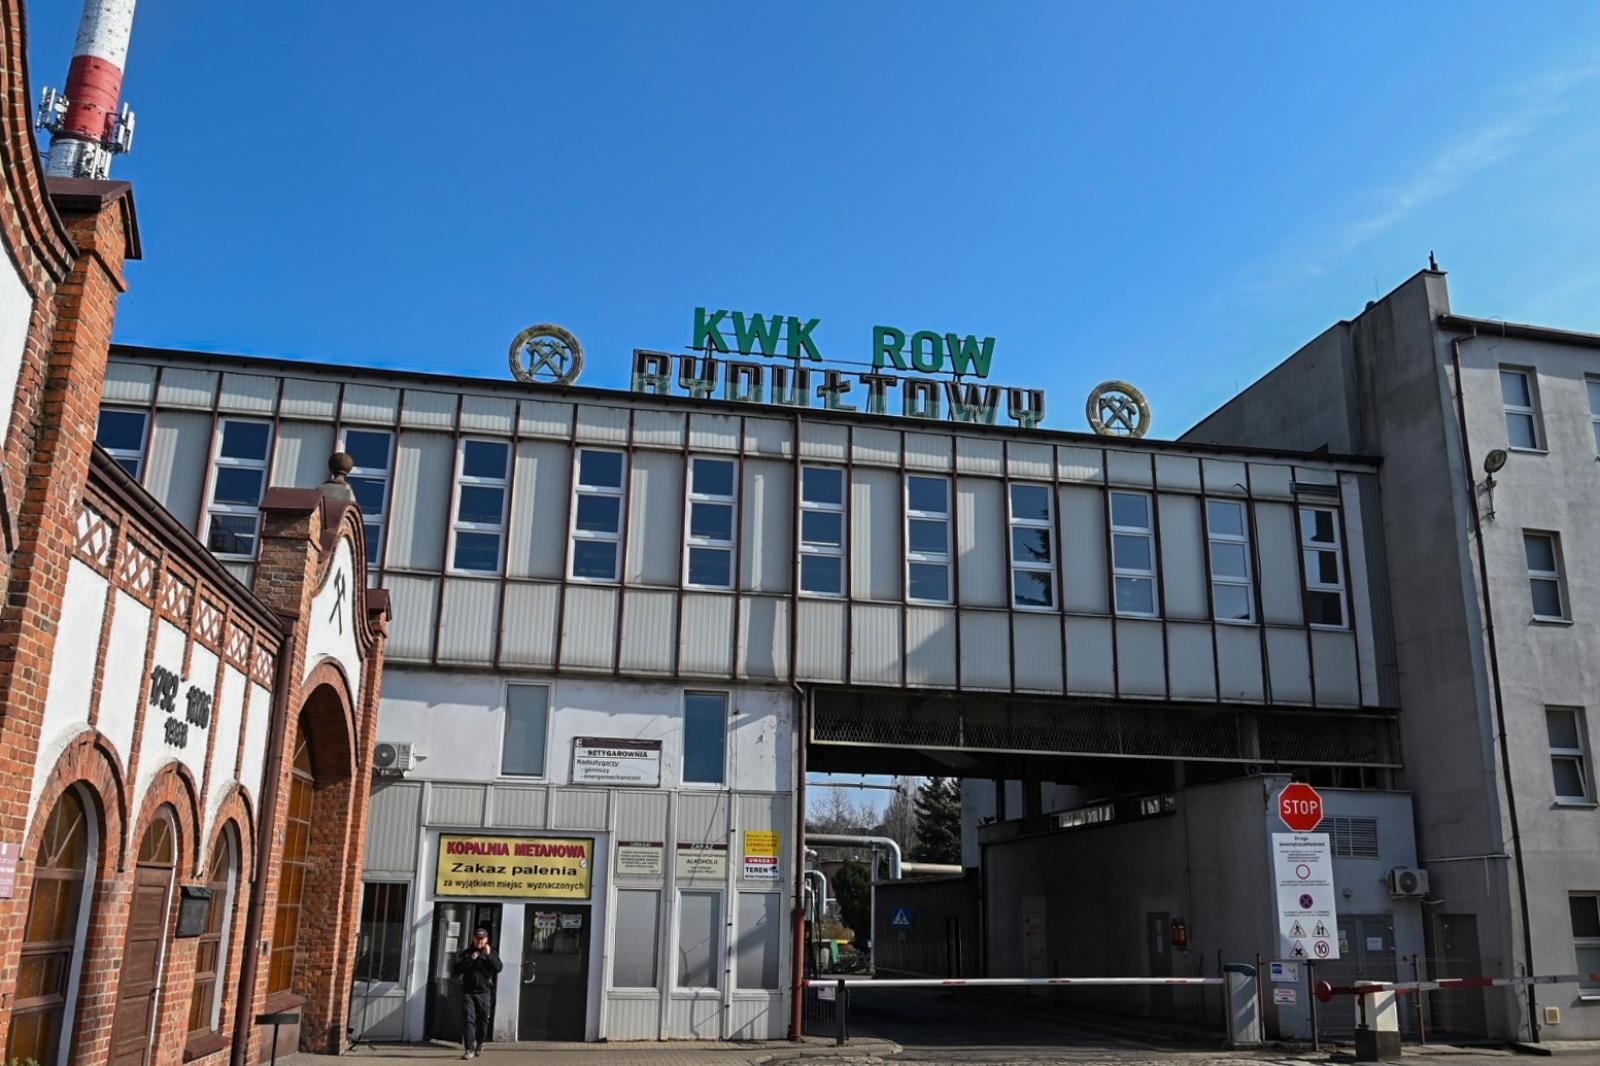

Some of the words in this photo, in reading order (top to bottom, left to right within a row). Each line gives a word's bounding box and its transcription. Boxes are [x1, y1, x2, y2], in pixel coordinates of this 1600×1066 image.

[692, 307, 823, 361] KWK
[873, 325, 996, 378] ROW
[631, 348, 1046, 428] RYDUŁTOWY
[1283, 799, 1318, 815] STOP
[446, 841, 510, 857] KOPALNIA
[514, 843, 586, 859] METANOWA
[450, 862, 507, 875] Zakaz
[511, 864, 578, 877] palenia
[443, 879, 453, 887] za
[455, 879, 496, 889] wyjątkiem
[496, 880, 523, 890] miejsc
[526, 881, 585, 892] wyznaczonych
[1317, 944, 1328, 956] 10
